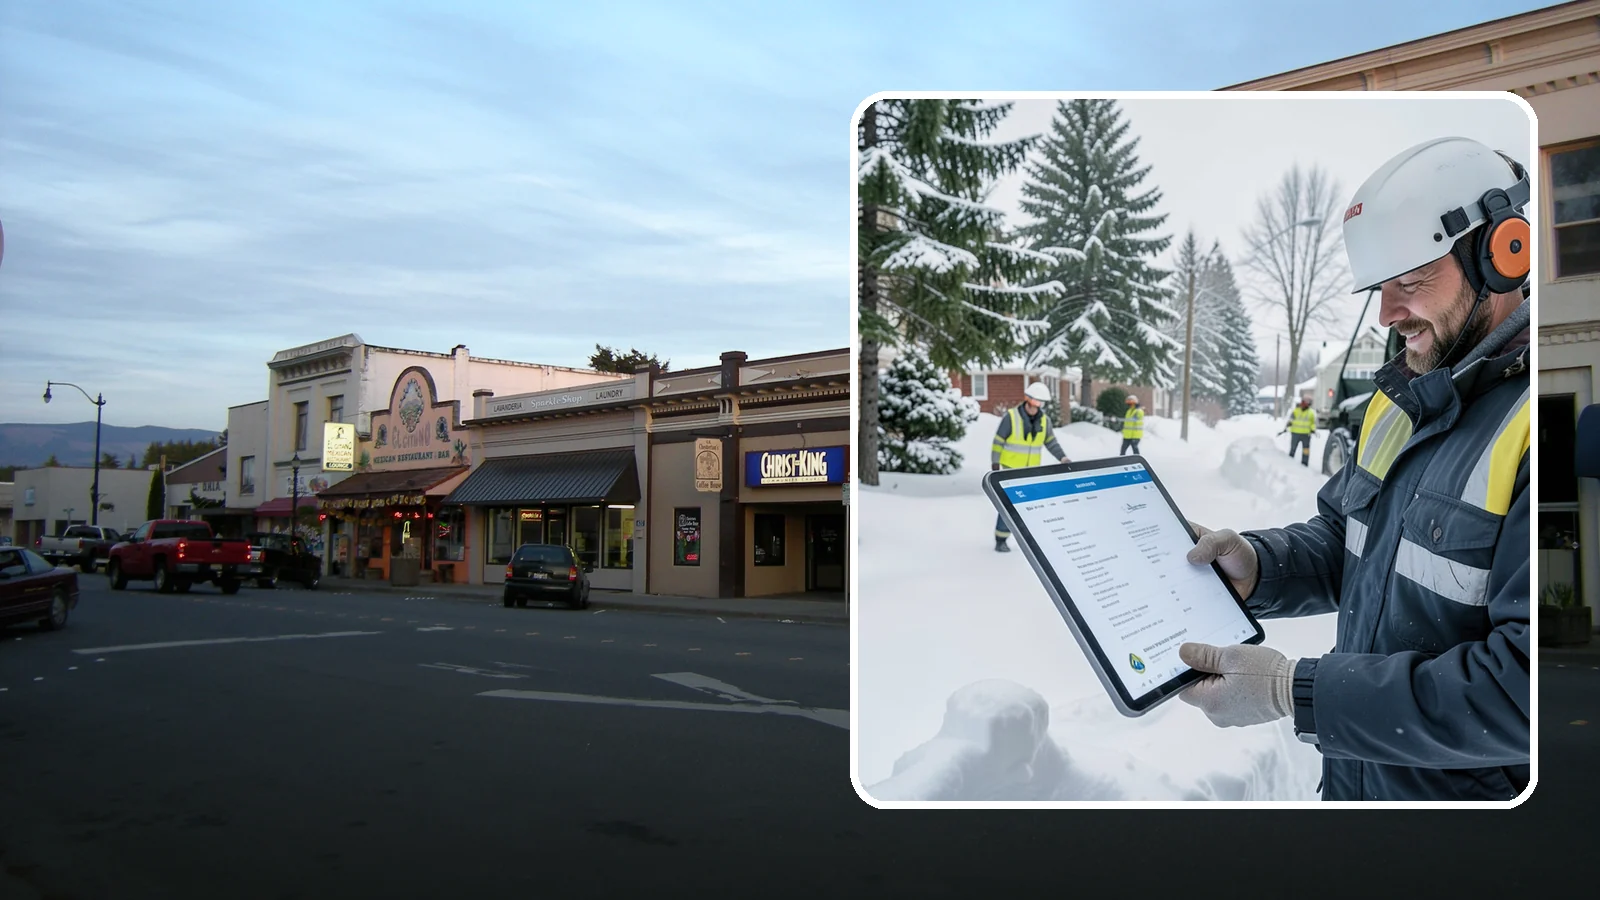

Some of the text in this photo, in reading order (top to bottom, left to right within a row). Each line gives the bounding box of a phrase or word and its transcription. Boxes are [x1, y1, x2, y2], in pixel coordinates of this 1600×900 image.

[595, 389, 623, 400] LAUNDRY
[561, 395, 582, 405] Shop
[493, 402, 522, 412] LAVANDERIA
[373, 450, 450, 464] MEXICAN RESTAURANT BAR
[696, 481, 721, 489] Coffee House
